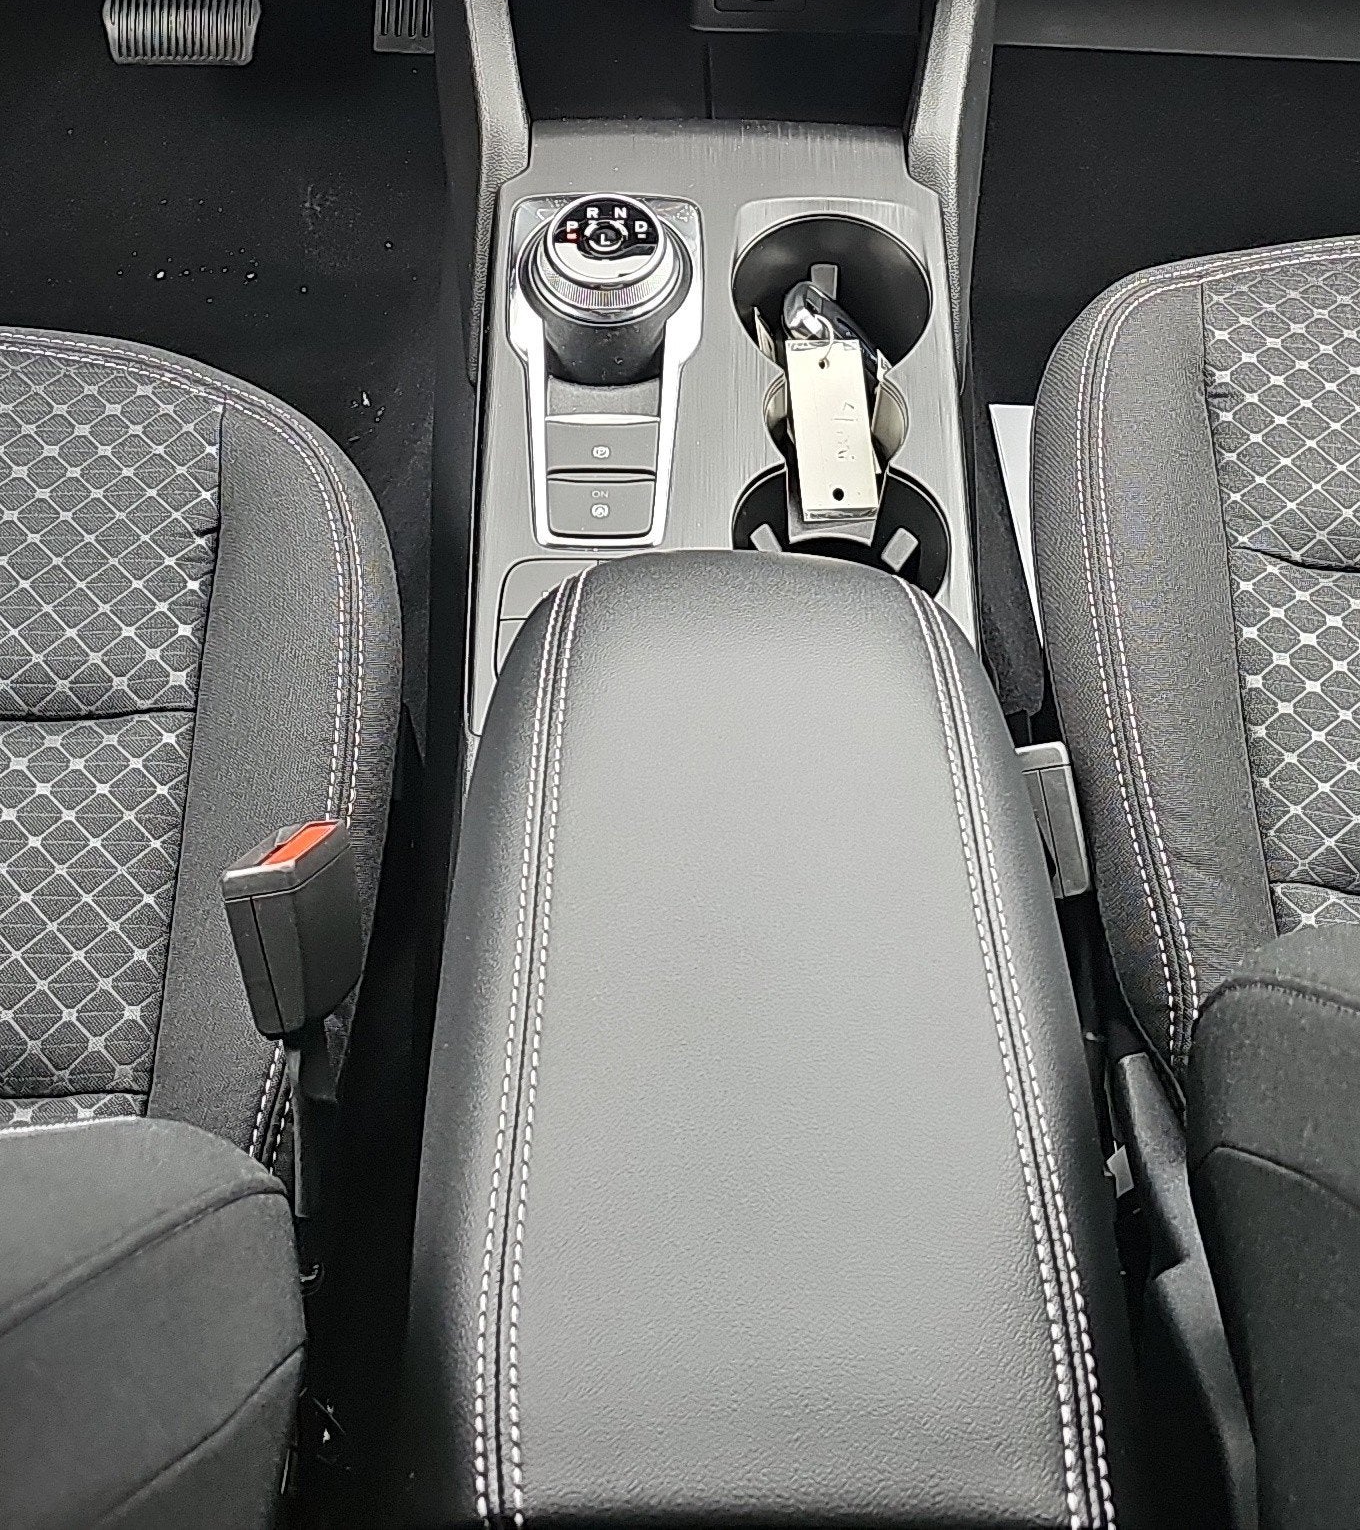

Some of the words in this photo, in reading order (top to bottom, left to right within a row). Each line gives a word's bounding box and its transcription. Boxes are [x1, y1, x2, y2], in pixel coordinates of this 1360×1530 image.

[586, 207, 599, 219] R
[614, 207, 627, 219] N
[566, 221, 579, 233] P
[634, 221, 648, 233] D
[600, 233, 611, 245] L
[591, 490, 609, 499] ON
